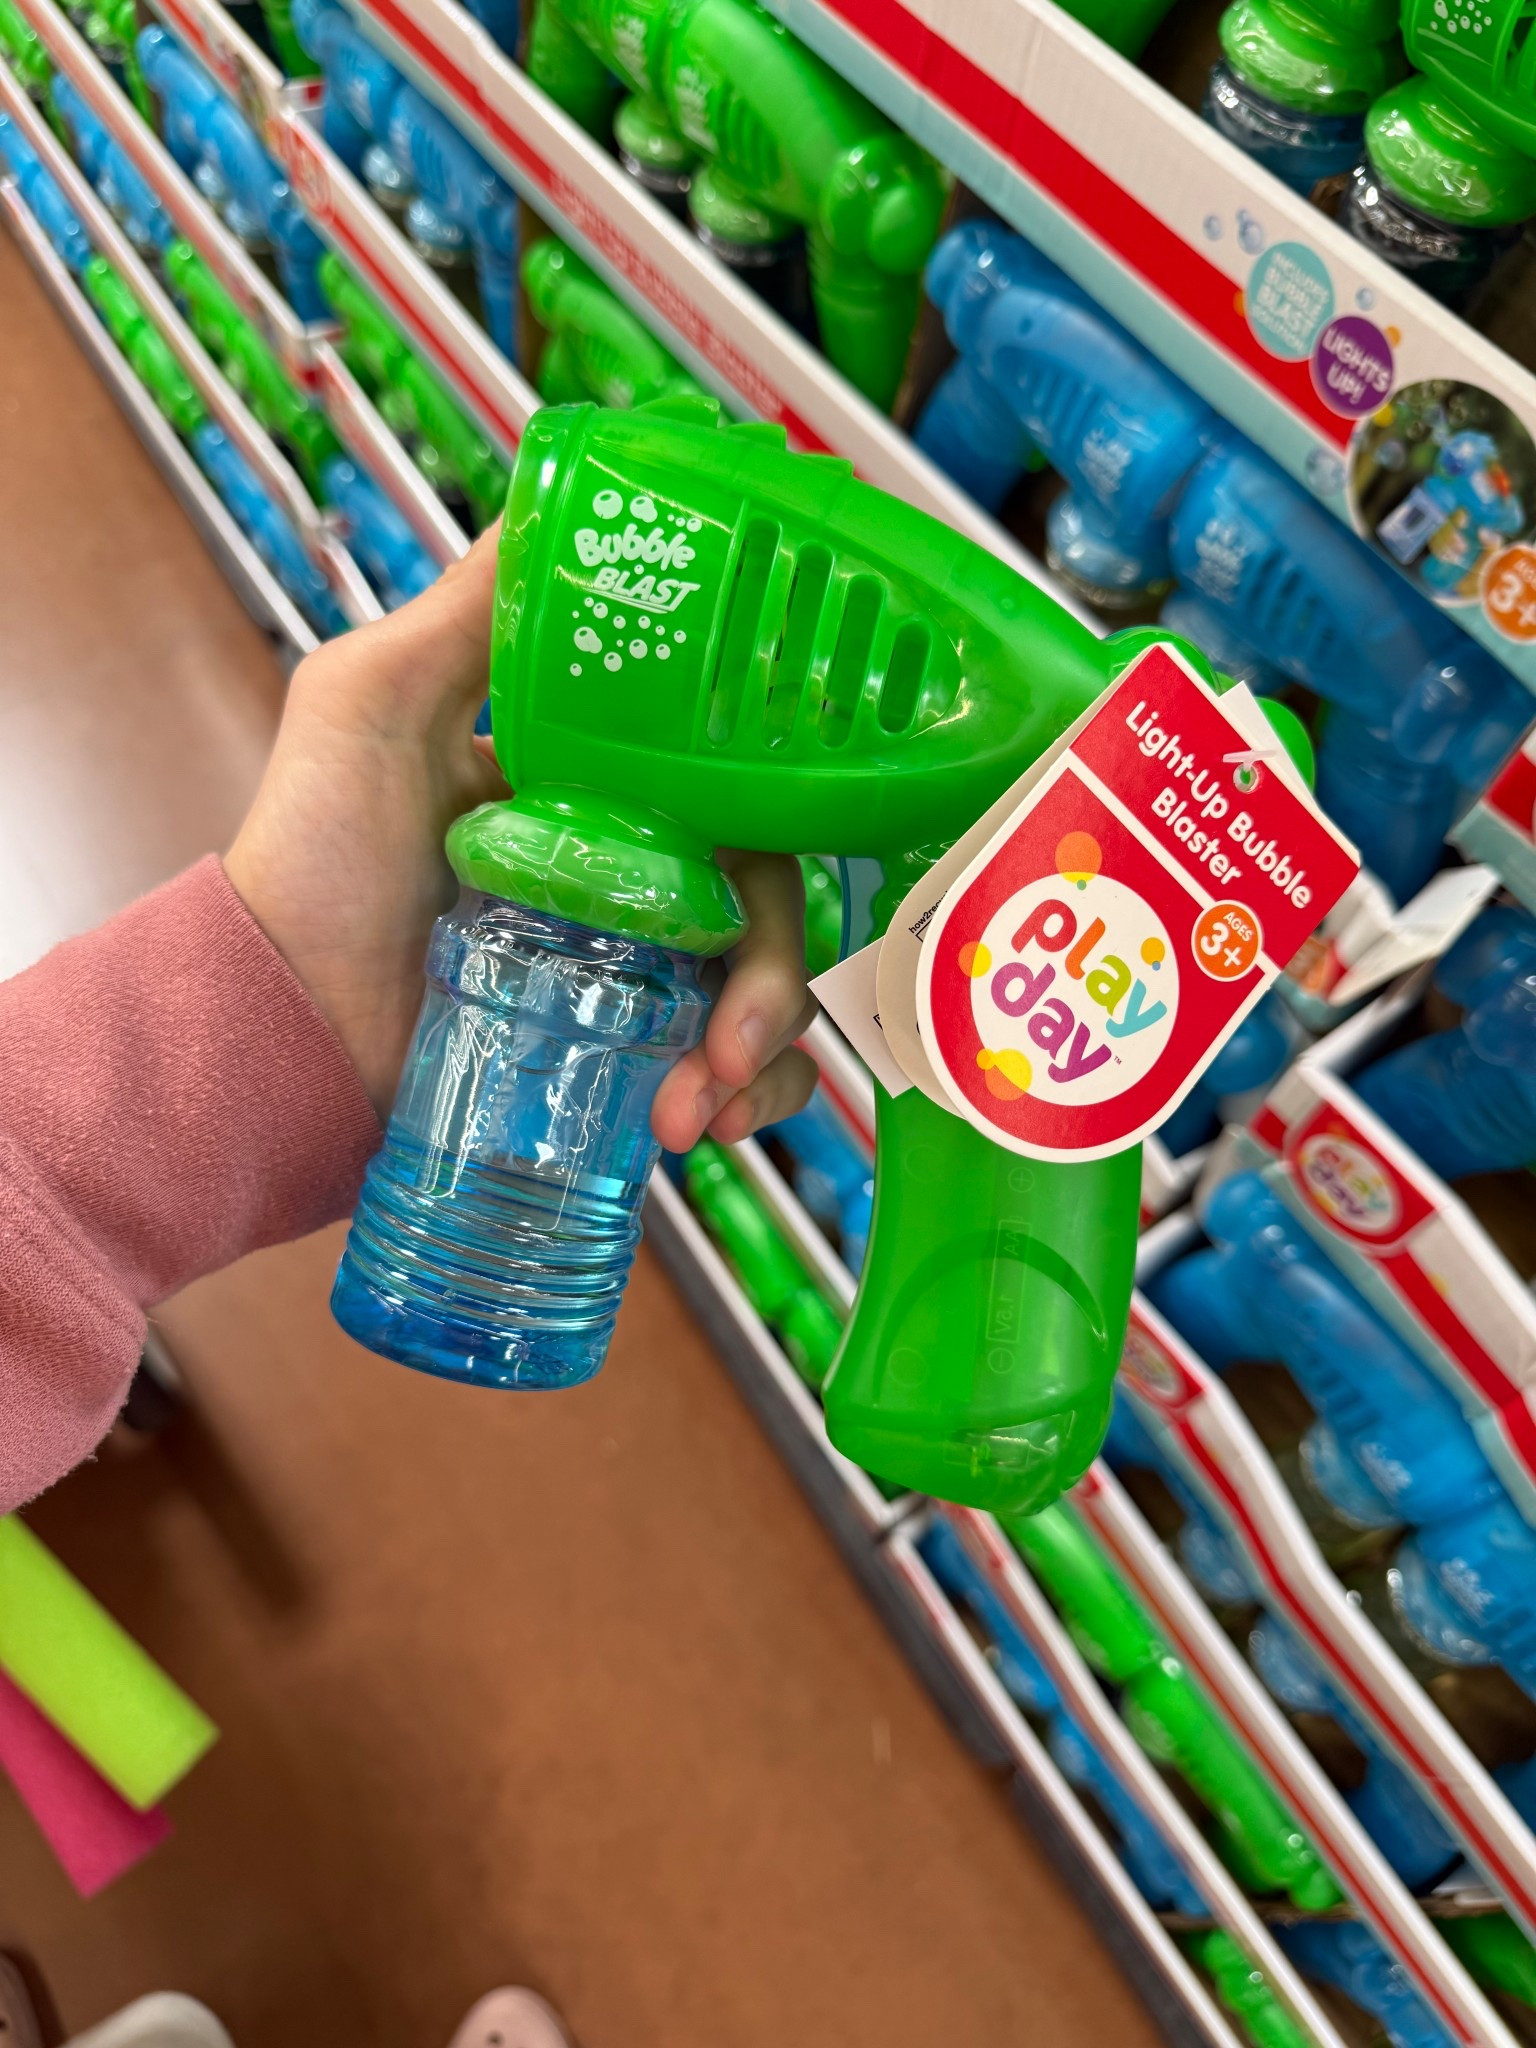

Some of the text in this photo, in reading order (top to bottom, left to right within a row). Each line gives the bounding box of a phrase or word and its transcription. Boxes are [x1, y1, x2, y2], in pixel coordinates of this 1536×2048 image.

[1257, 285, 1314, 338] BLAST
[1322, 327, 1391, 393] LIGHTS
[1326, 362, 1367, 404] UP!
[574, 523, 696, 571] Bubble
[594, 567, 701, 612] BLAST
[1488, 571, 1536, 628] 3+
[1125, 700, 1229, 819] Light-Up
[1226, 811, 1313, 909] Bubble
[1151, 786, 1243, 885] Blaster
[1200, 922, 1243, 968] 3+
[1222, 911, 1253, 942] AGES
[1011, 899, 1168, 1038] play
[991, 962, 1112, 1083] day
